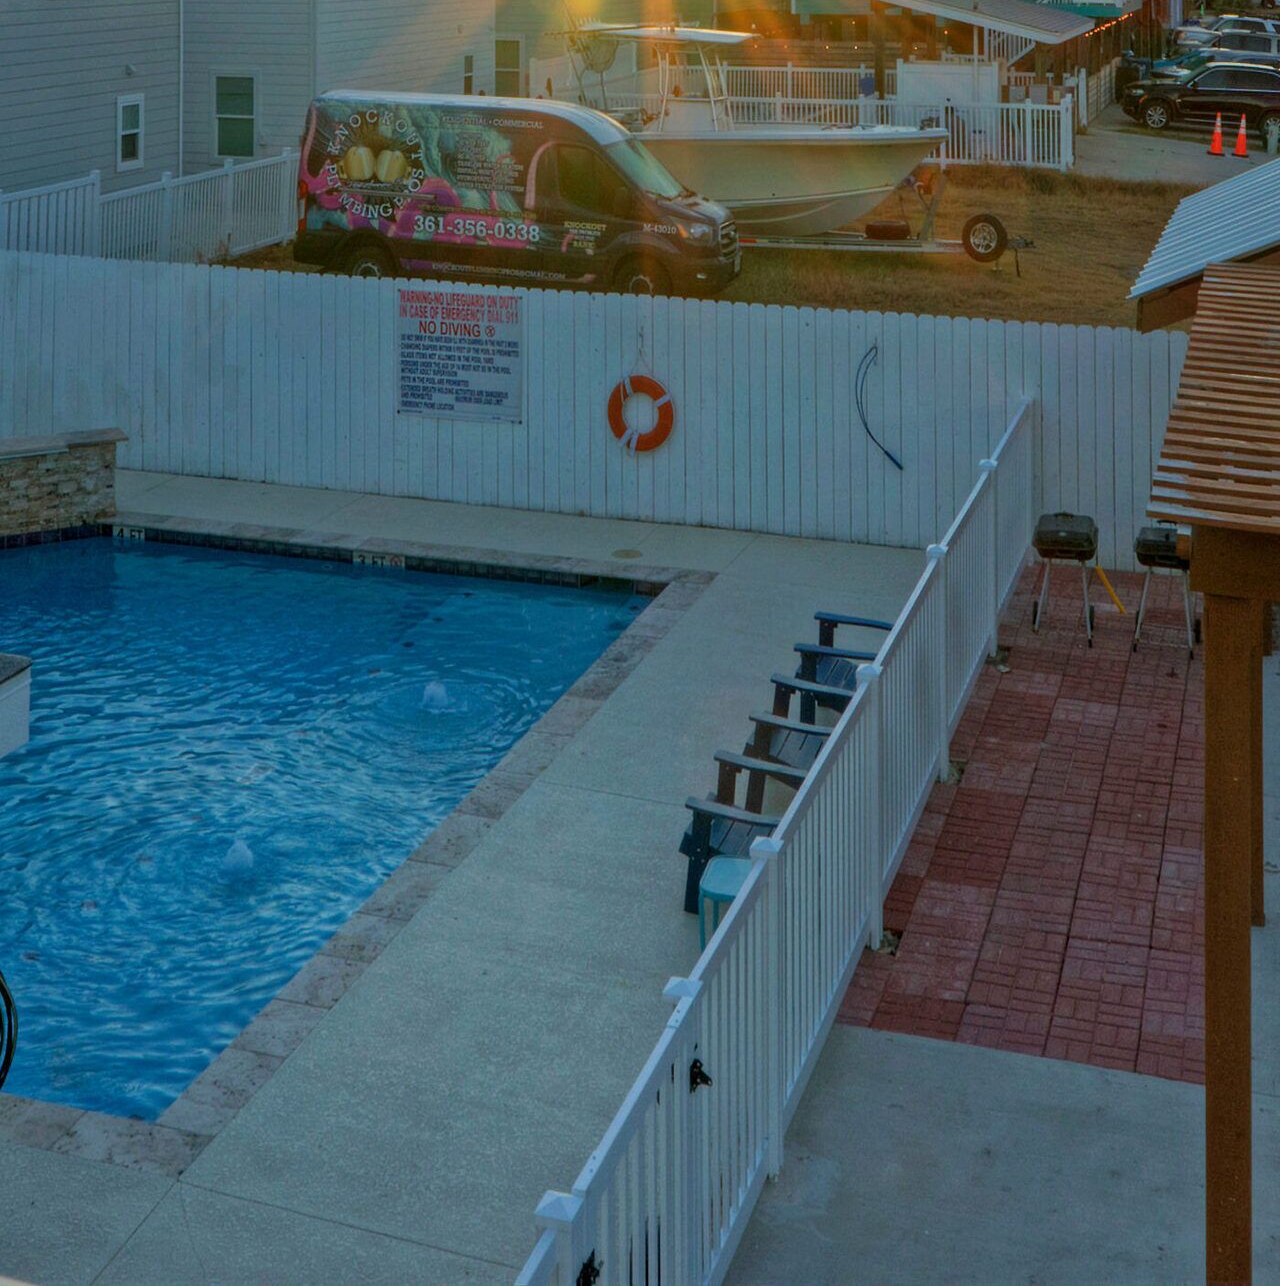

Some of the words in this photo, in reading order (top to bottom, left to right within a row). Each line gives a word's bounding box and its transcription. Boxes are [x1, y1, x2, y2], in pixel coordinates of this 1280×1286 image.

[492, 118, 544, 130] COMMERCIAL
[327, 109, 423, 160] KNOCKOUT
[414, 215, 540, 242] 361-356-0338
[445, 293, 485, 307] LIFEGUARD
[487, 295, 497, 308] ON
[499, 296, 519, 310] DUTY
[400, 305, 408, 318] IN
[409, 305, 429, 319] CASE
[430, 306, 439, 319] OF
[441, 307, 485, 323] EMERGENCY
[487, 310, 504, 323] DIAL
[506, 311, 519, 324] 911
[419, 321, 437, 334] NO
[439, 322, 481, 337] DIVING
[117, 528, 124, 538] 4
[130, 529, 143, 540] FT
